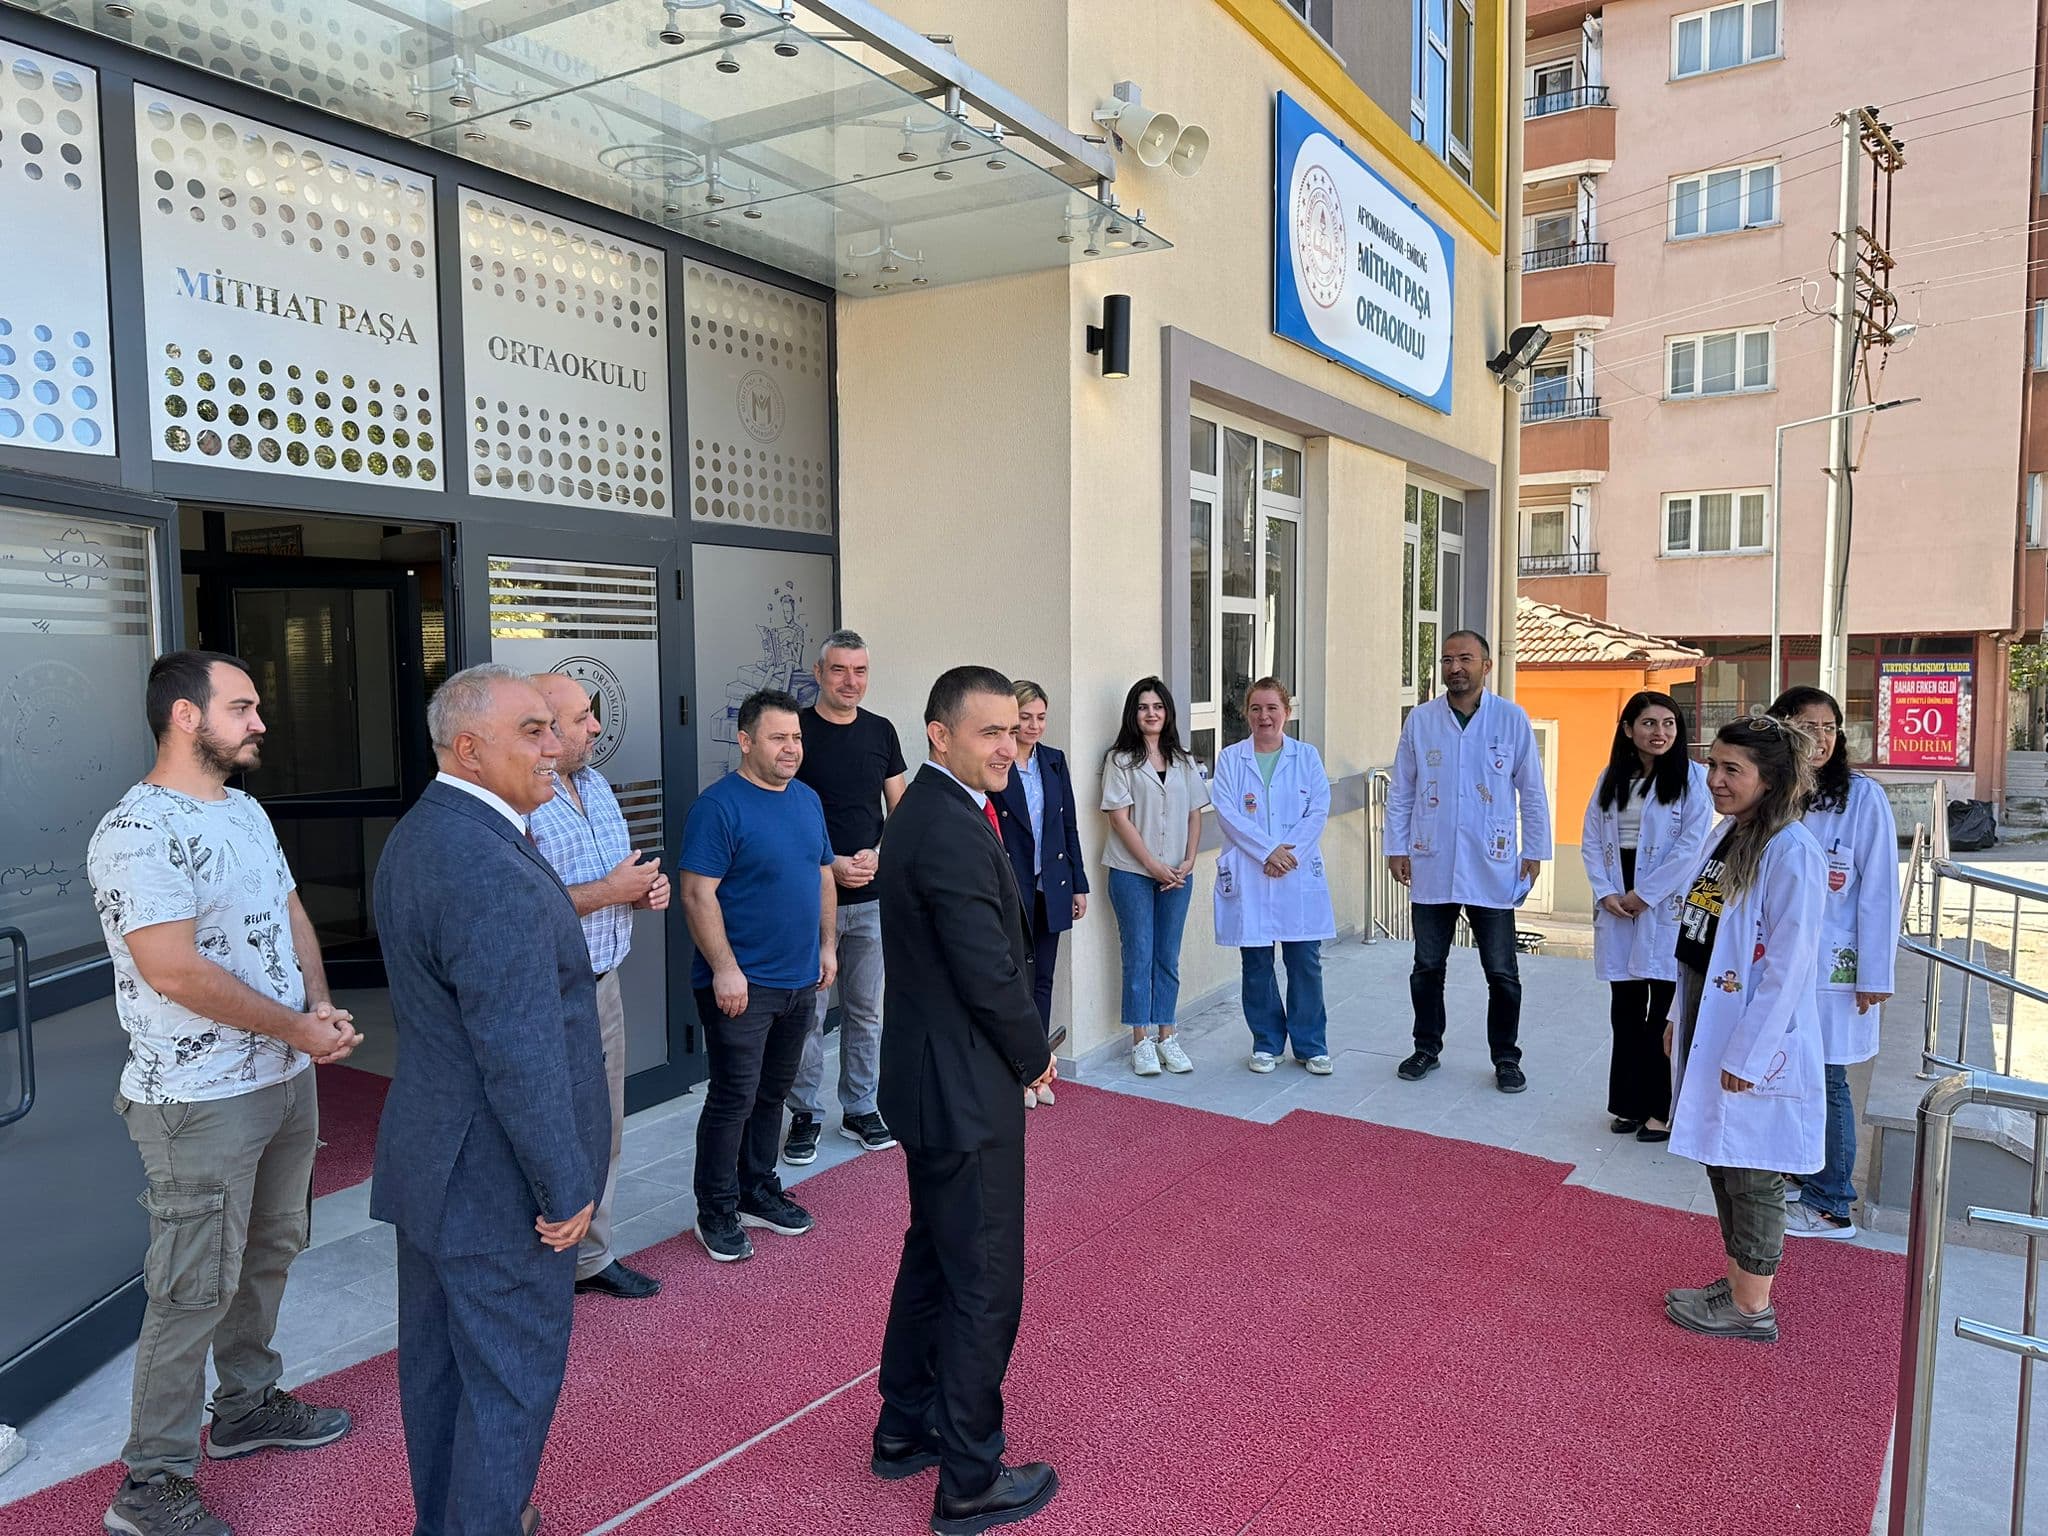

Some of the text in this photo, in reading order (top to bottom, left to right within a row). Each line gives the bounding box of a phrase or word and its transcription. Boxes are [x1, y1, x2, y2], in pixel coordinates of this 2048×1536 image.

[1358, 204, 1404, 256] AFYONKARAHİSAR
[176, 267, 418, 345] MİTHAT PAŞA
[1358, 242, 1430, 320] MİTHAT PAŞA
[1357, 295, 1425, 361] ORTAOKULU
[488, 335, 647, 392] ORTAOKULU
[1882, 663, 1912, 675] YURTDIŞI
[1946, 663, 1970, 673] VARDIR
[1893, 678, 1957, 694] BAHAR ERKEN GELDİ
[592, 670, 620, 726] ORTAOKULU
[1893, 736, 1952, 752] İNDİRİM
[244, 911, 271, 926] BELIVE
